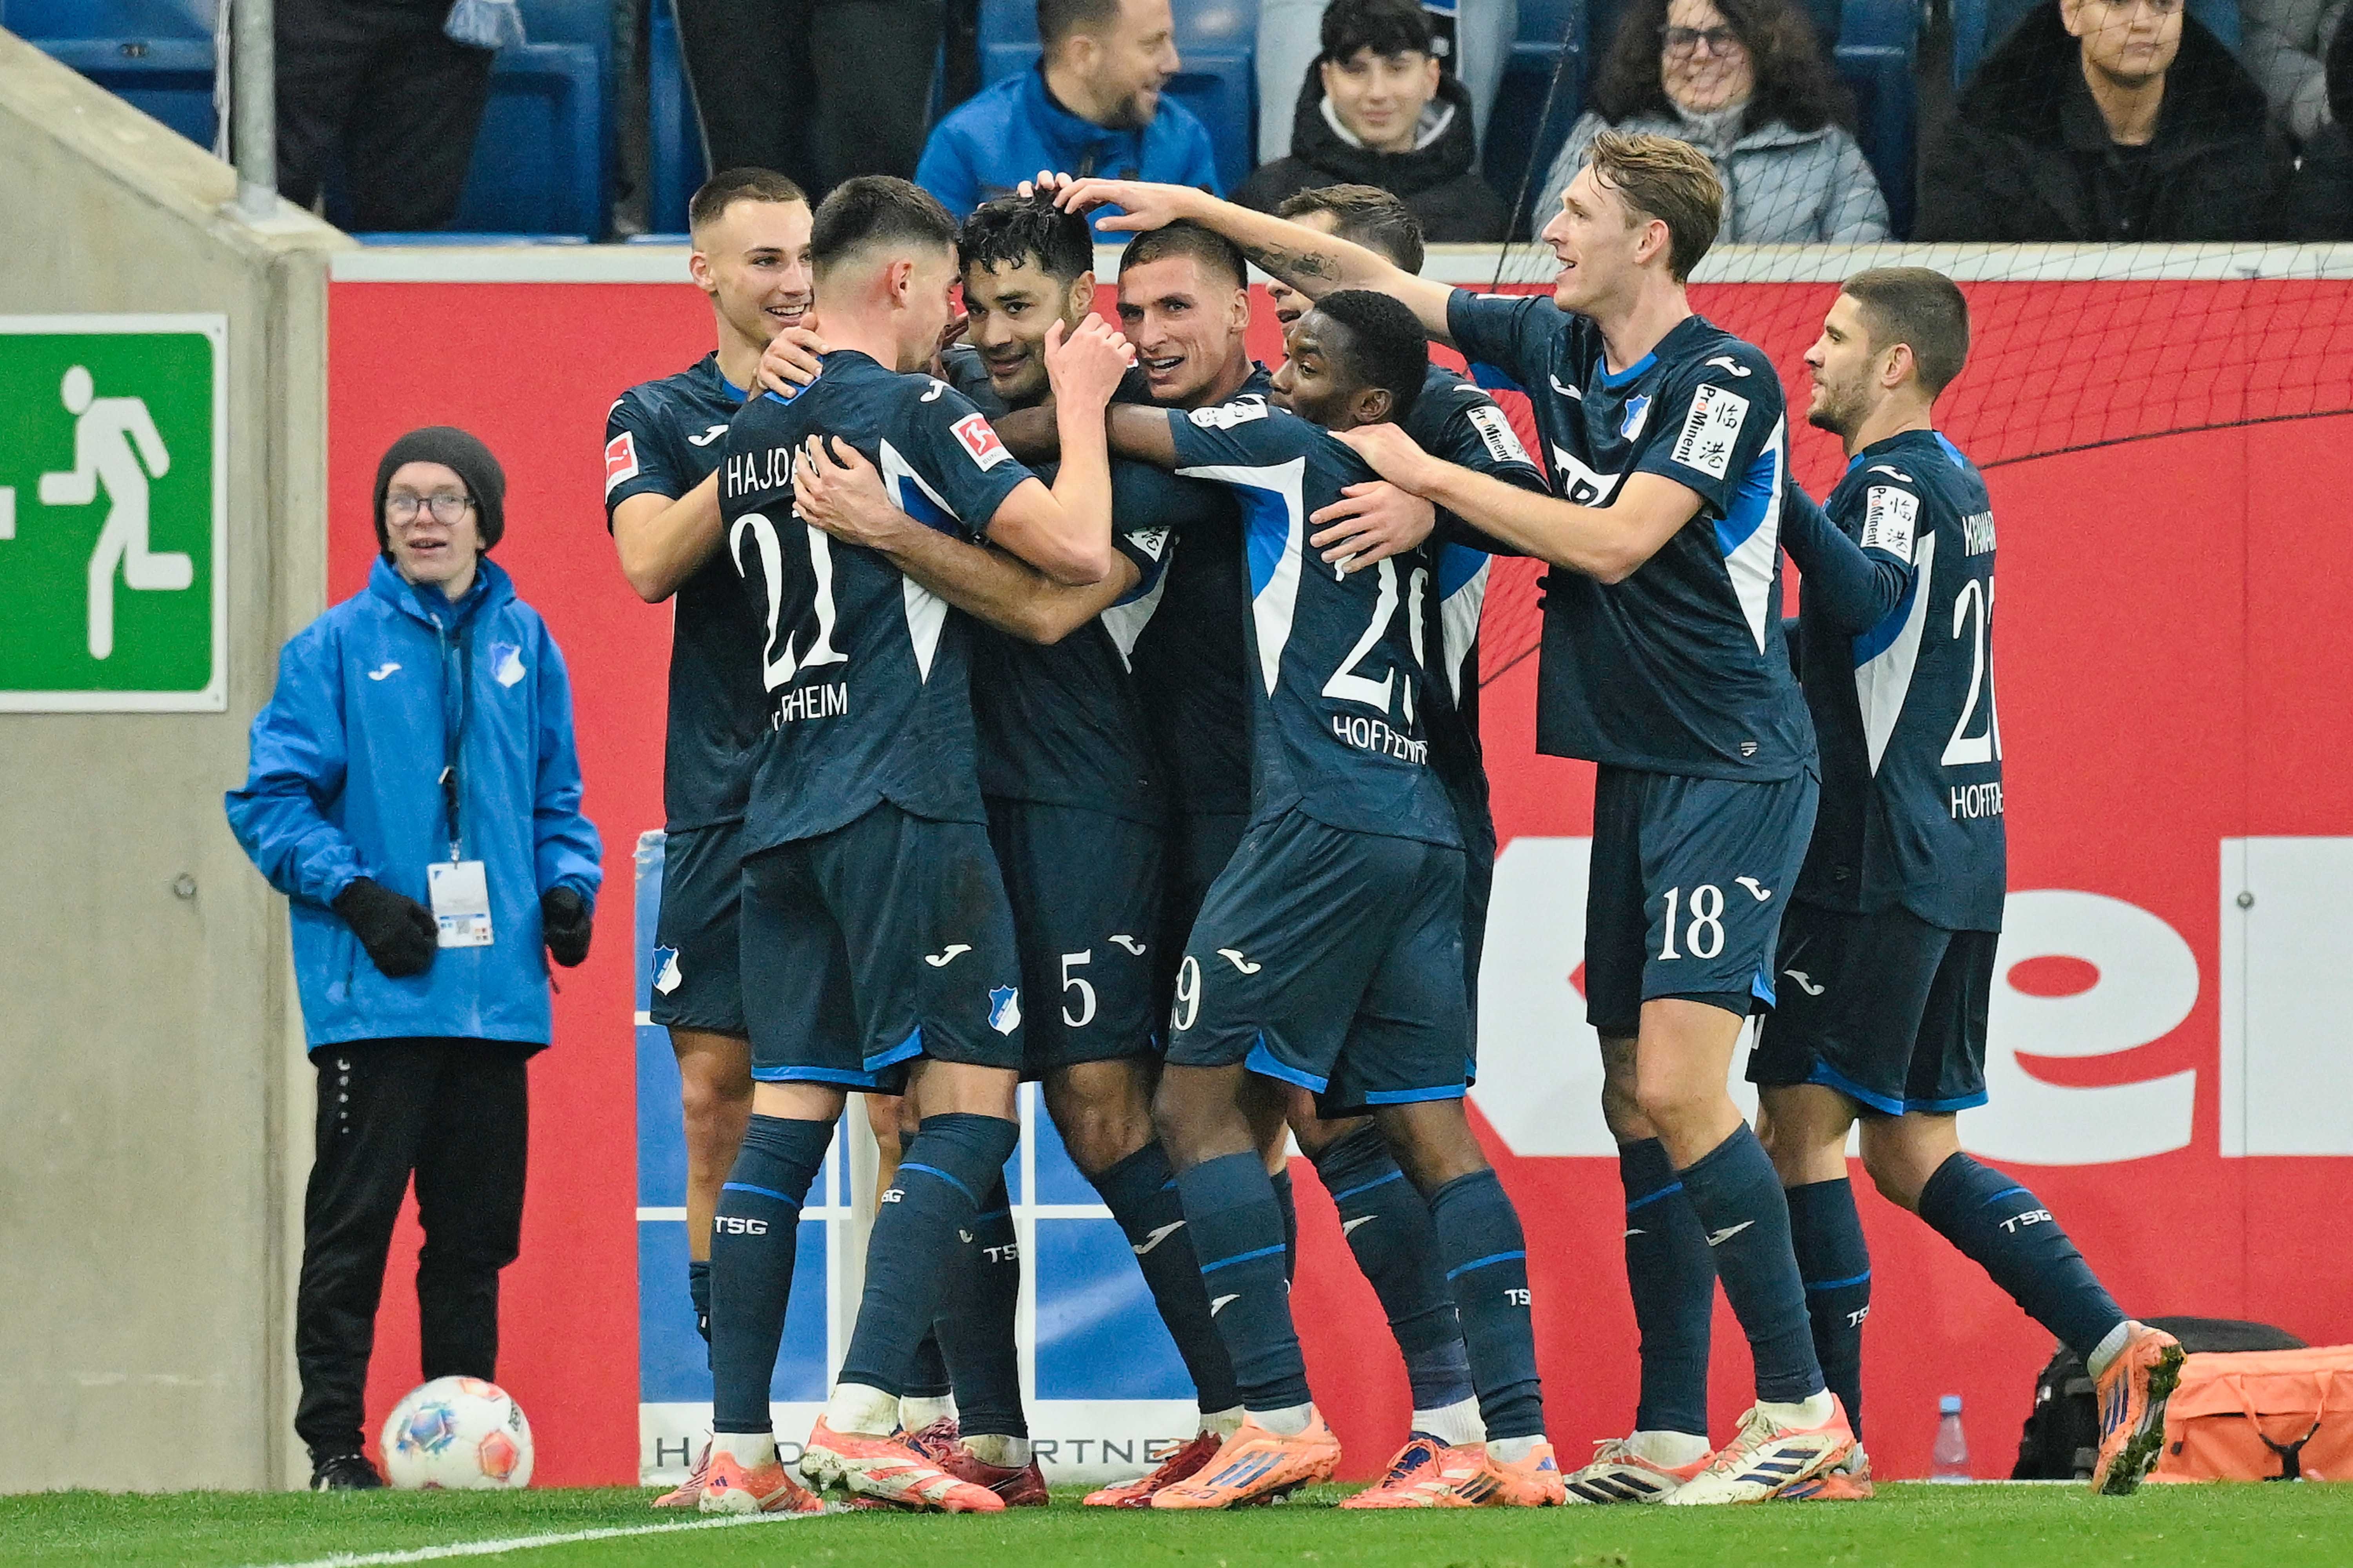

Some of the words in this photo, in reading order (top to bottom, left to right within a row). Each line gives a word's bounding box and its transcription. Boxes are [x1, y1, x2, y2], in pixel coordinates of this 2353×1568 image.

[1471, 408, 1513, 461] ProMinent
[1676, 386, 1717, 463] ProMinent
[1866, 487, 1887, 545] ProMinent
[729, 513, 849, 693] 21
[1657, 884, 1725, 961] 18
[1061, 948, 1096, 1027] 5
[715, 1216, 769, 1235] TSG
[1999, 1209, 2053, 1233] TSG
[983, 1243, 1017, 1263] TS
[1504, 1288, 1531, 1306] TS
[1846, 1304, 1870, 1328] TS
